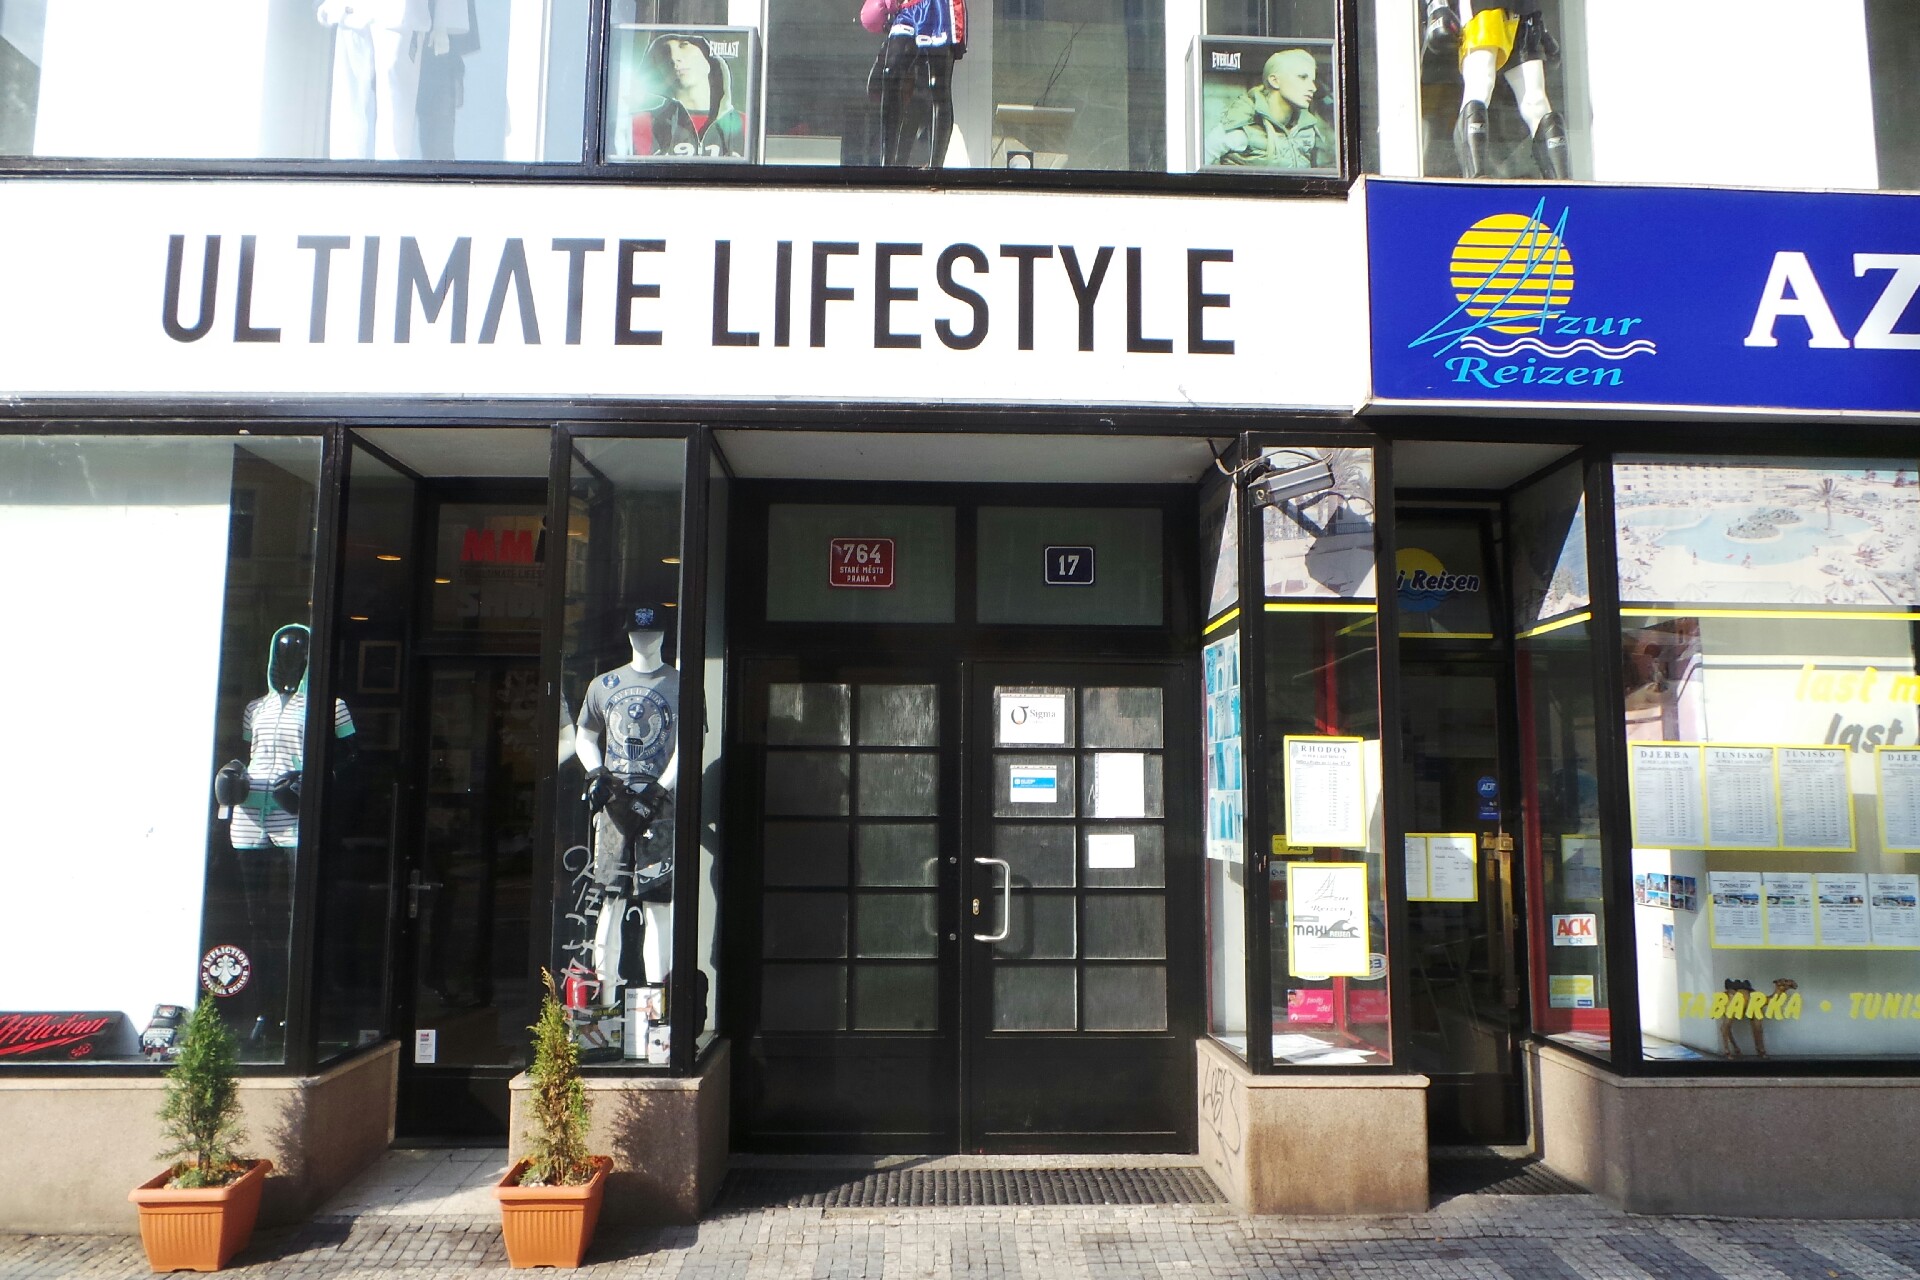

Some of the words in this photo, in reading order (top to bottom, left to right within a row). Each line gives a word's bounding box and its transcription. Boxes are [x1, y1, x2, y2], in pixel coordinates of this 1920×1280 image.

[709, 40, 740, 58] EVERLAST
[1210, 50, 1241, 69] EVERLAST
[162, 234, 668, 346] ULTIMATE
[711, 239, 1236, 355] LIFESTYLE
[1444, 356, 1625, 389] Reizen
[843, 543, 881, 564] 764
[862, 564, 884, 574] MĚSTO
[1058, 554, 1080, 576] 17
[846, 575, 870, 583] PRAHA
[1410, 568, 1480, 592] Reisen
[1029, 708, 1057, 720] Sigma
[1300, 745, 1348, 754] RHODOS
[1640, 750, 1689, 759] DJERBA
[1714, 751, 1764, 759] TUNISKO
[1785, 750, 1836, 758] TUNISKO
[1481, 782, 1496, 792] ADT
[1293, 924, 1327, 937] MAXI
[1557, 918, 1592, 936] ACK
[202, 946, 249, 969] AFFLICTION
[227, 970, 249, 994] DEALER
[1679, 991, 1802, 1020] TABARKA
